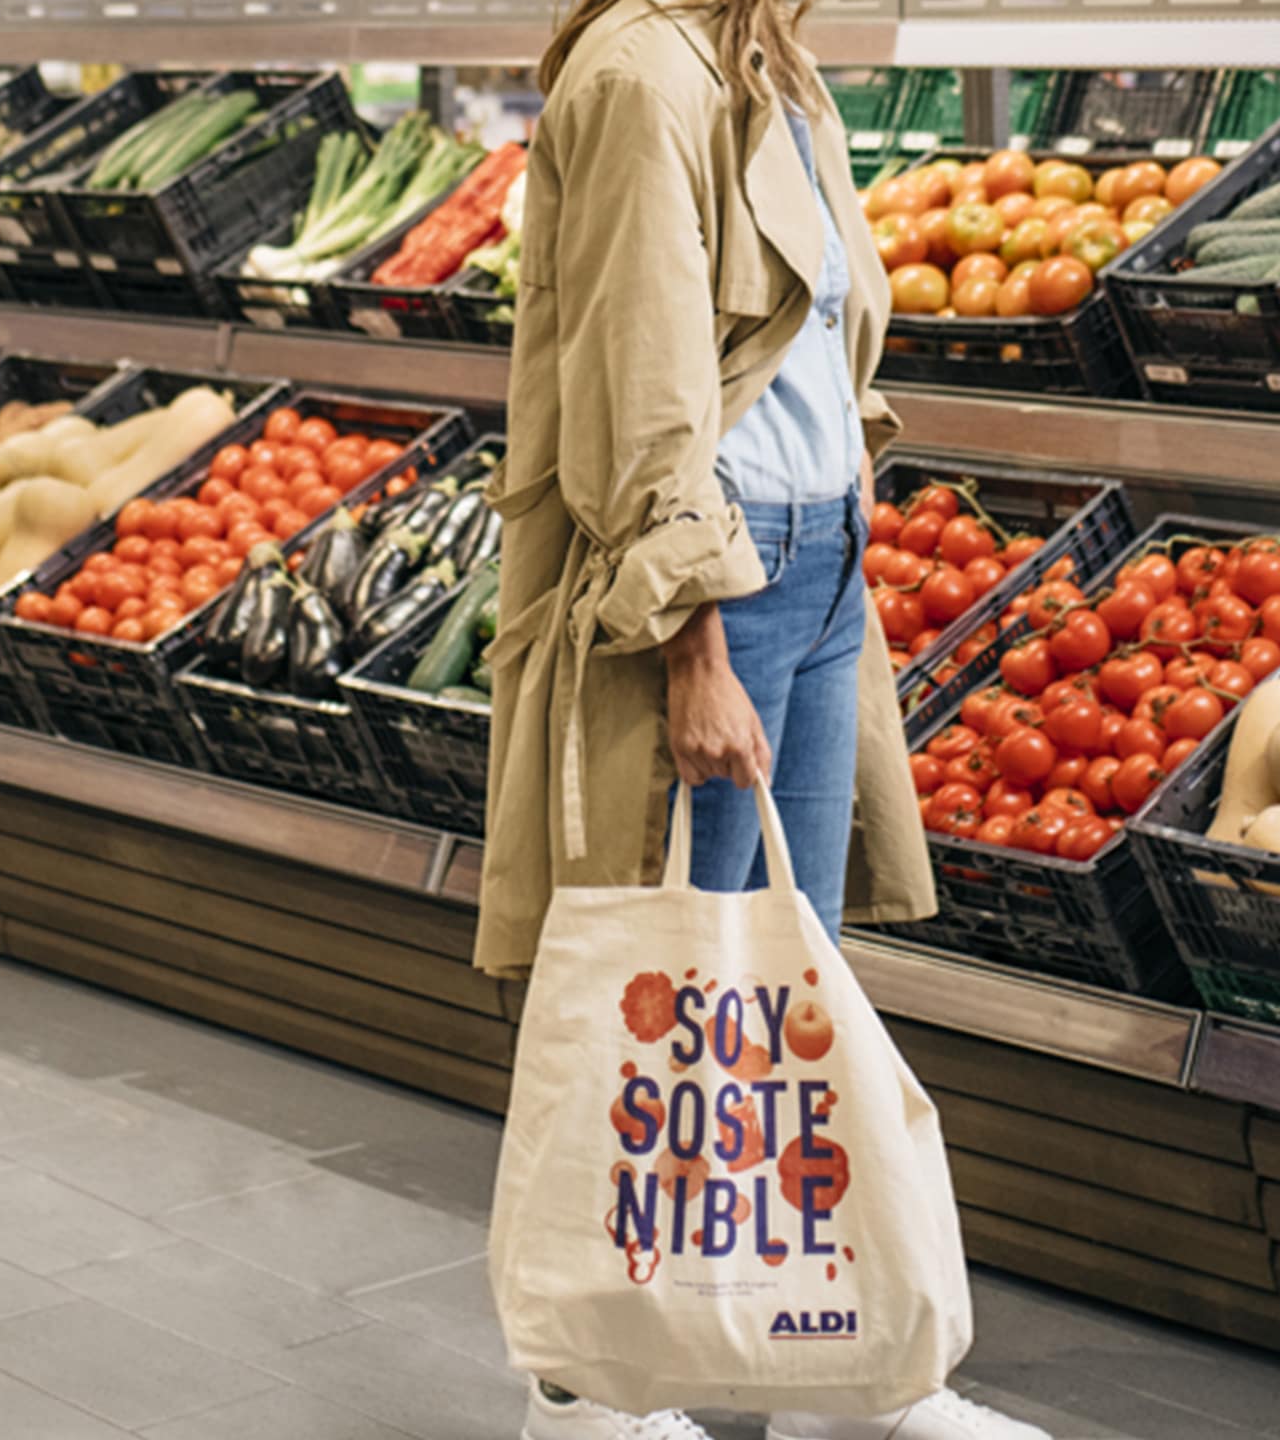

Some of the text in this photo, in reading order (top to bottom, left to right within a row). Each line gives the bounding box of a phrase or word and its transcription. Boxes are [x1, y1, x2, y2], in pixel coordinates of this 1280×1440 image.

[671, 986, 790, 1067] SOY
[620, 1076, 834, 1161] SOSTE
[614, 1170, 836, 1257] NIBLE
[769, 1311, 857, 1334] ALDI
